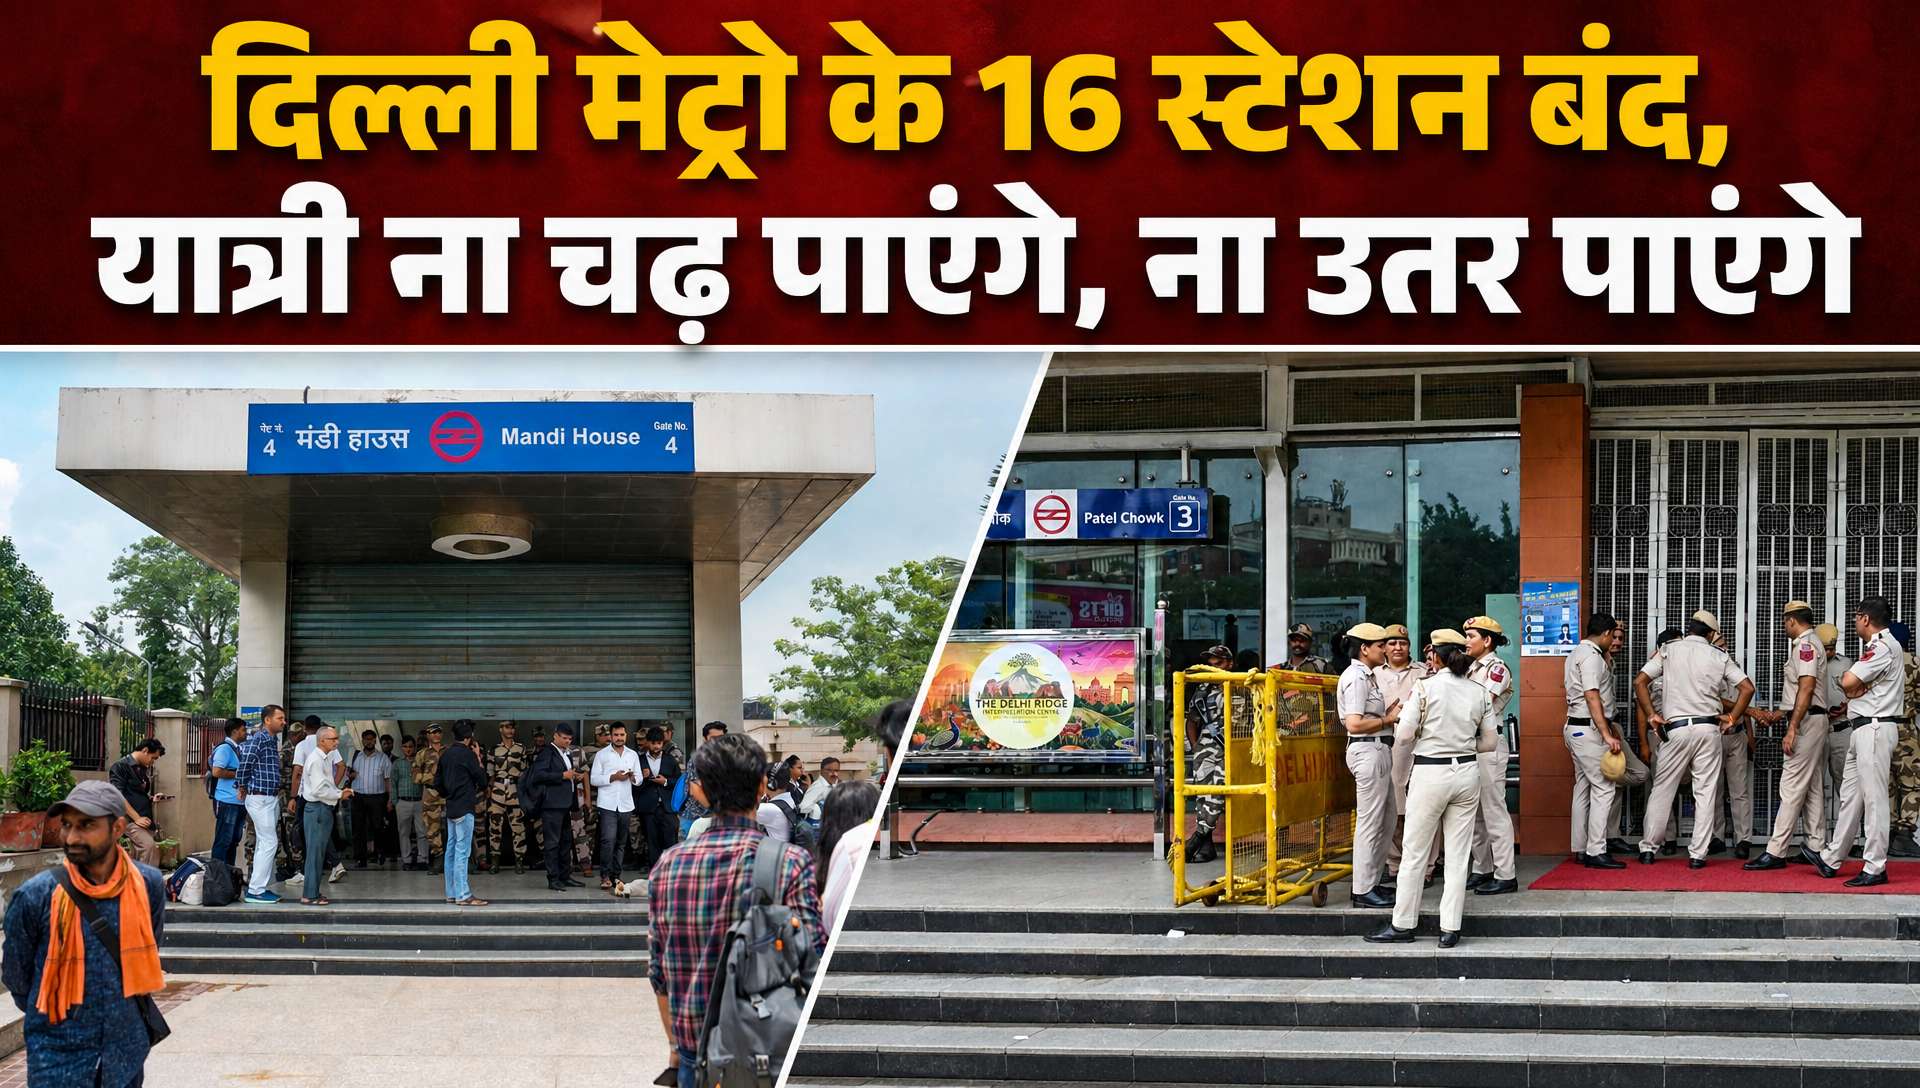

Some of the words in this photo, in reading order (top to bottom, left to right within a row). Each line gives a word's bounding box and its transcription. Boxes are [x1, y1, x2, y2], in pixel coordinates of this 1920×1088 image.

[653, 421, 673, 431] Gate
[674, 421, 688, 431] No.
[295, 423, 341, 450] मंडी
[347, 429, 410, 452] हाउस
[501, 427, 565, 445] Mandi
[573, 427, 641, 445] House
[664, 436, 678, 454] 4
[263, 438, 276, 457] 4
[1084, 511, 1117, 525] Patel
[1120, 511, 1165, 525] Chowk
[1177, 505, 1193, 528] 3
[975, 699, 997, 709] THE
[1000, 699, 1031, 709] DELHI
[1034, 699, 1068, 709] RIDGE
